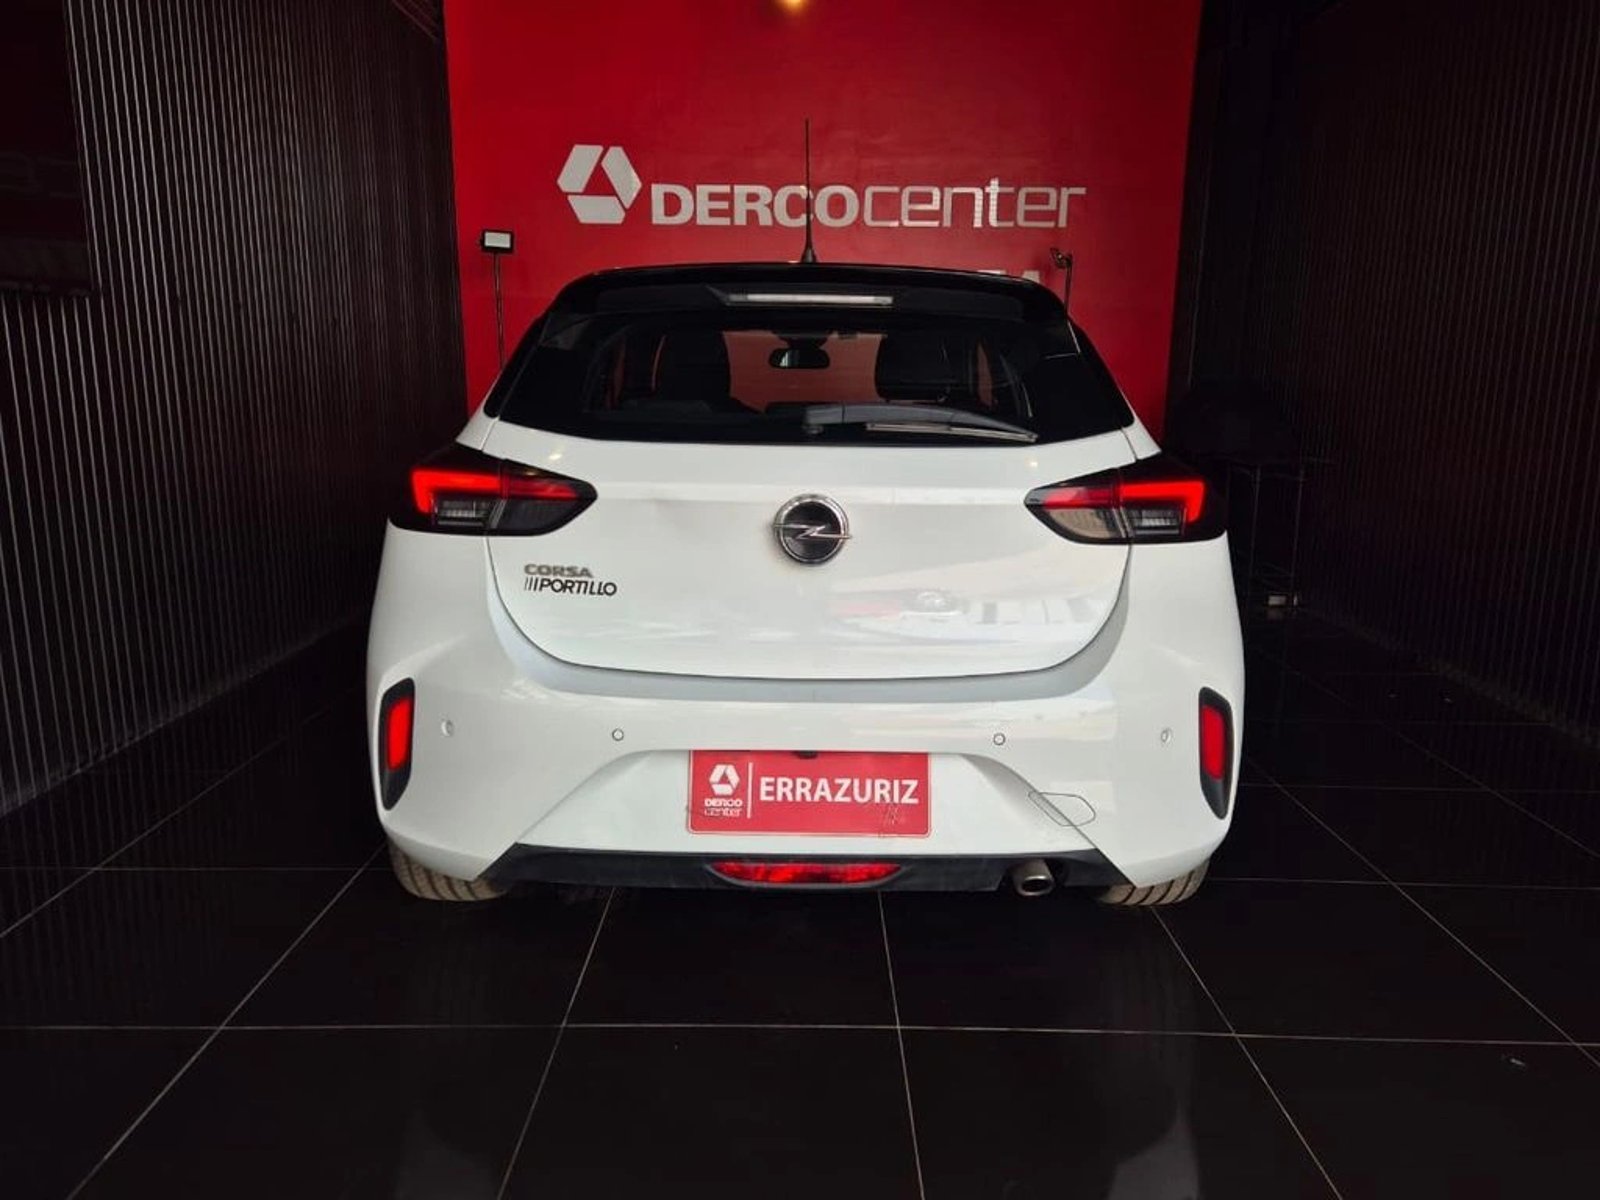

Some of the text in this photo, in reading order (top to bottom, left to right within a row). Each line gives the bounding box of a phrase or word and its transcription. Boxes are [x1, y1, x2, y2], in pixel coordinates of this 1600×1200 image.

[651, 178, 1087, 228] DERCOcenter
[524, 563, 594, 578] CORSA
[540, 578, 617, 596] PORTILLO
[760, 777, 919, 804] ERRAZURIZ
